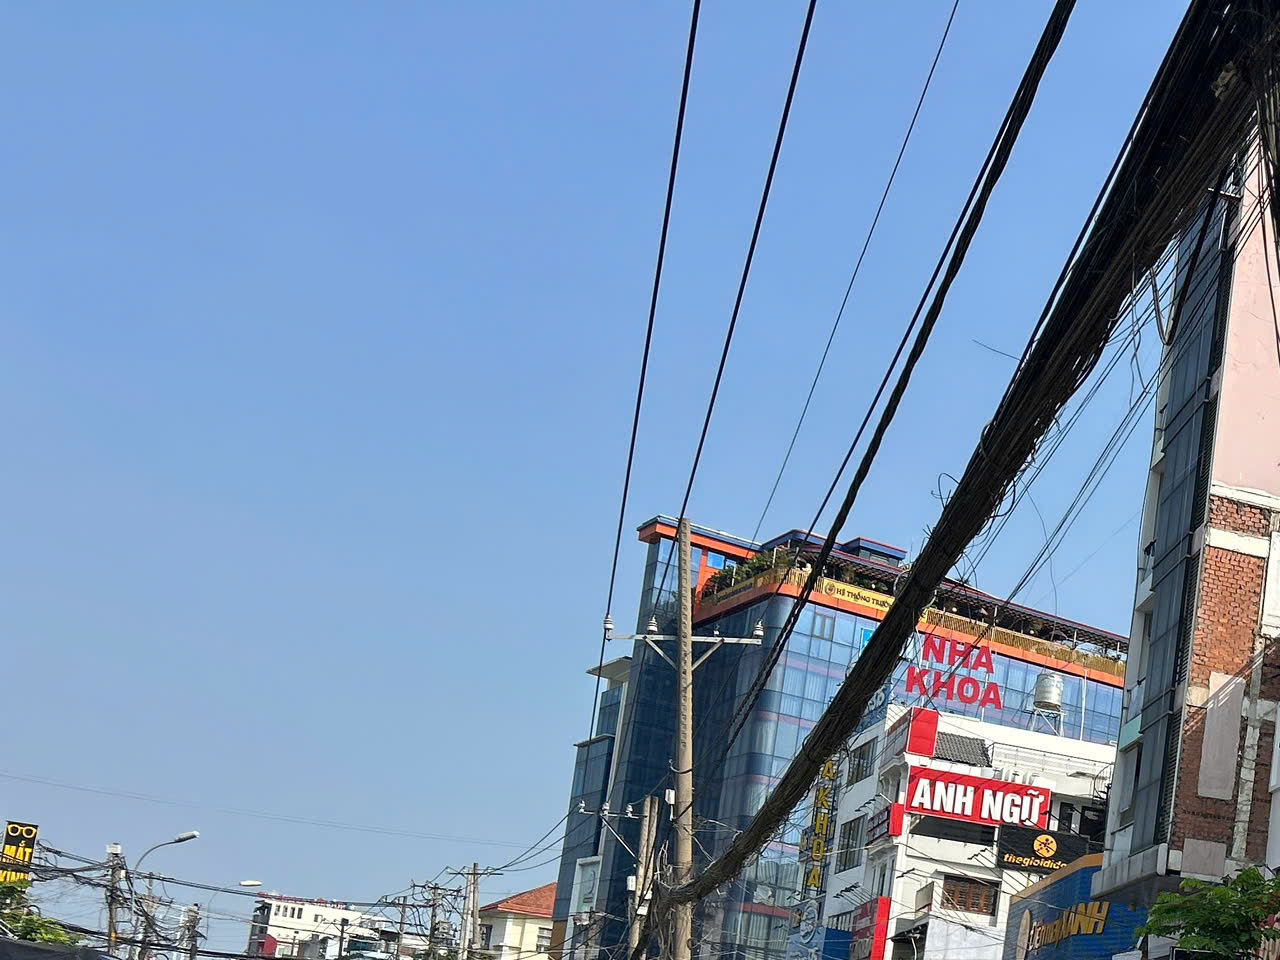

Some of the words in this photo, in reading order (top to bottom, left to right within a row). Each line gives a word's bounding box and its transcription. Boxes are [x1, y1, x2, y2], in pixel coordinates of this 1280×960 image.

[921, 633, 995, 674] NHA
[905, 665, 1003, 710] KHOA
[911, 777, 974, 816] ANH
[980, 789, 1044, 827] NGỮ
[807, 786, 832, 888] KHOA
